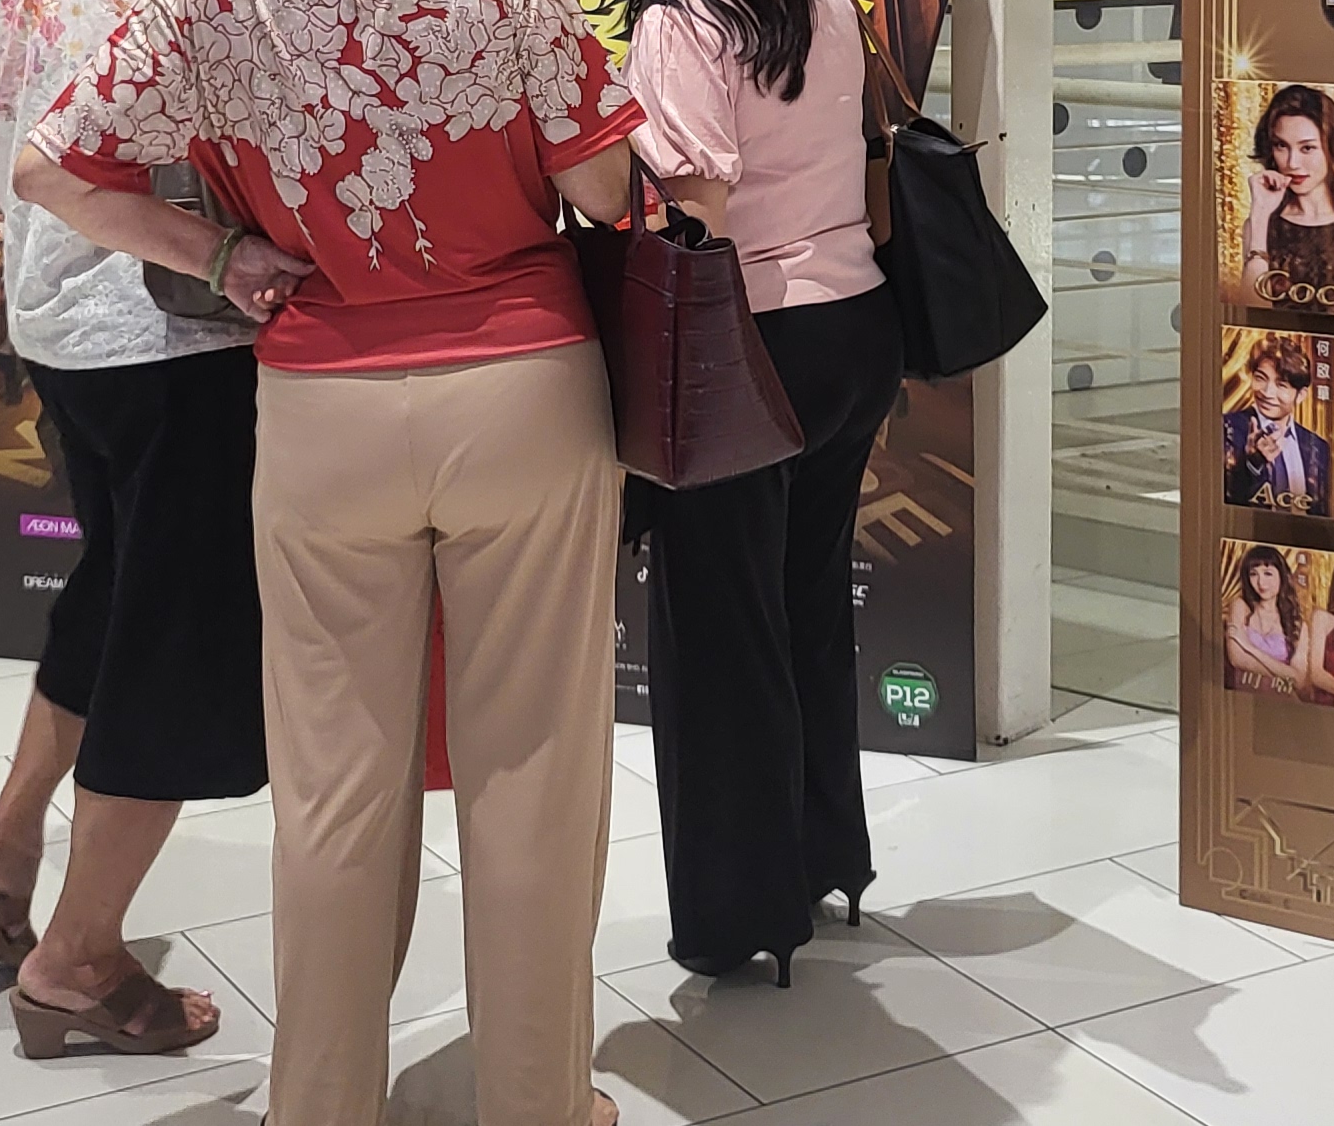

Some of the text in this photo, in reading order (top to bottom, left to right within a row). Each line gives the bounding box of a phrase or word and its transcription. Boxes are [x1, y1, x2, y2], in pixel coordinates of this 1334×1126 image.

[1249, 482, 1314, 512] Ace
[60, 521, 81, 534] MA
[886, 684, 932, 710] P12
